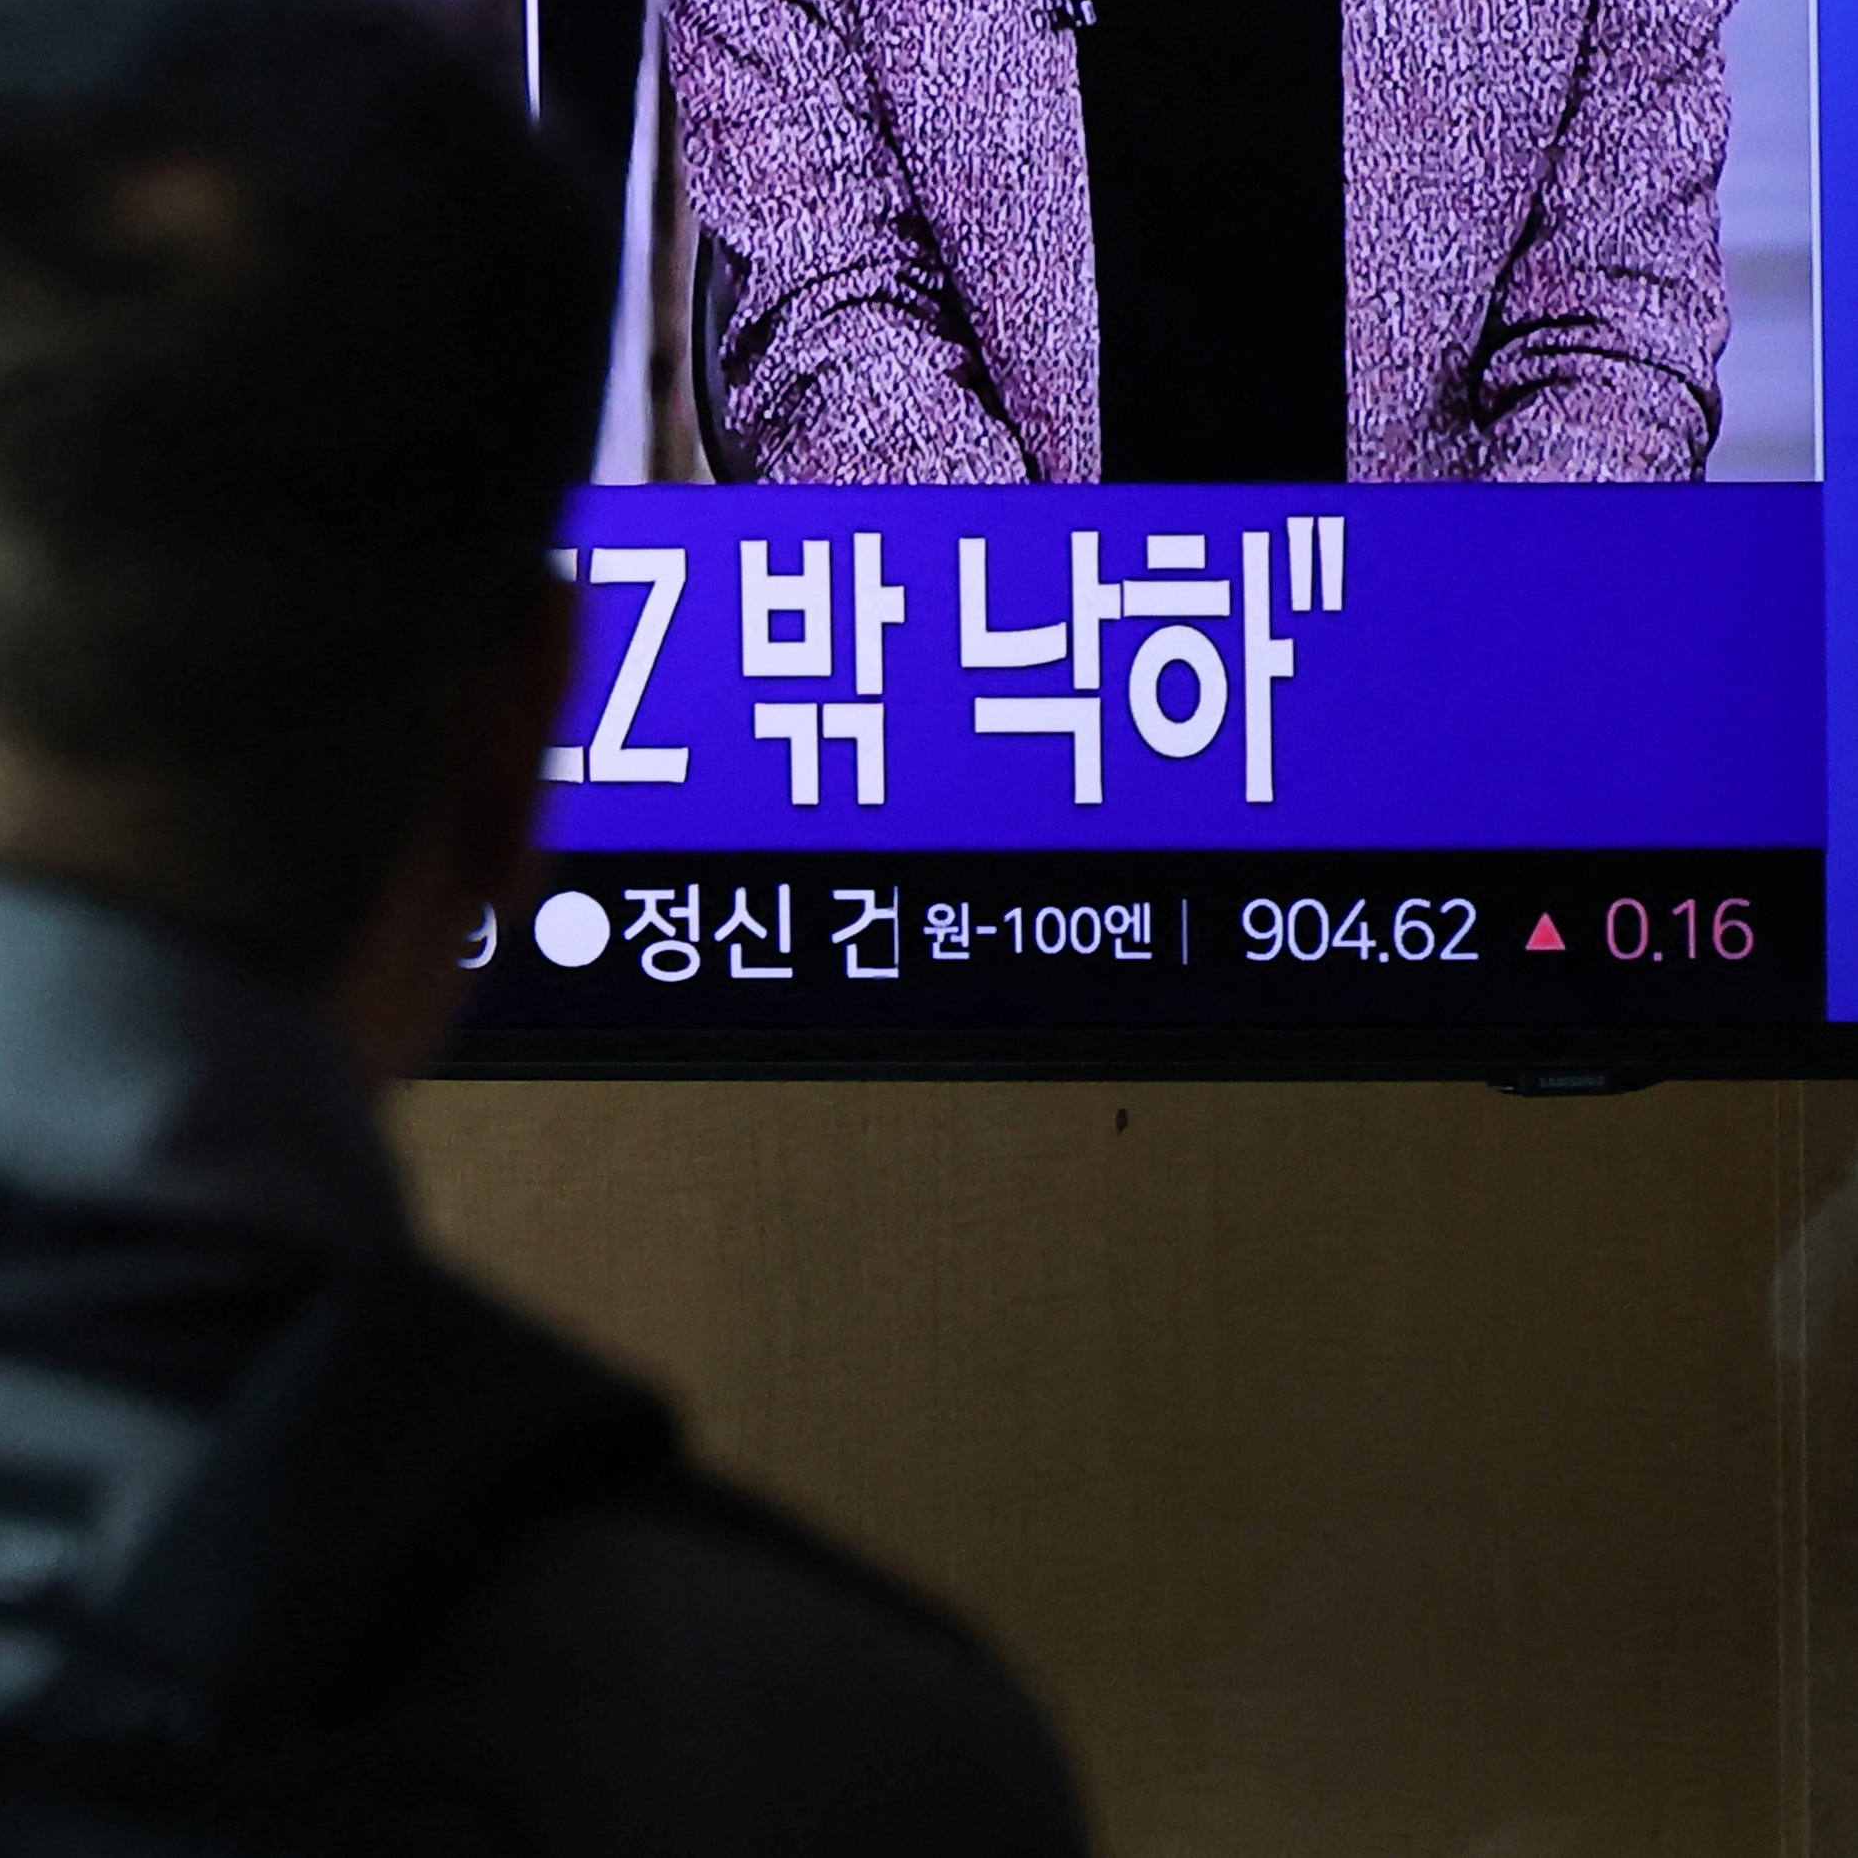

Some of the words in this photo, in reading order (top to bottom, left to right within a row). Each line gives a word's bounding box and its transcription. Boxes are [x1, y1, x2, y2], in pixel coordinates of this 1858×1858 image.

[739, 532, 906, 805] 밖
[958, 515, 1346, 804] 낙하"
[624, 883, 795, 982] 정신
[922, 901, 1154, 961] 원-100엔
[1241, 897, 1480, 963] 904.62
[1605, 897, 1756, 962] 0.16
